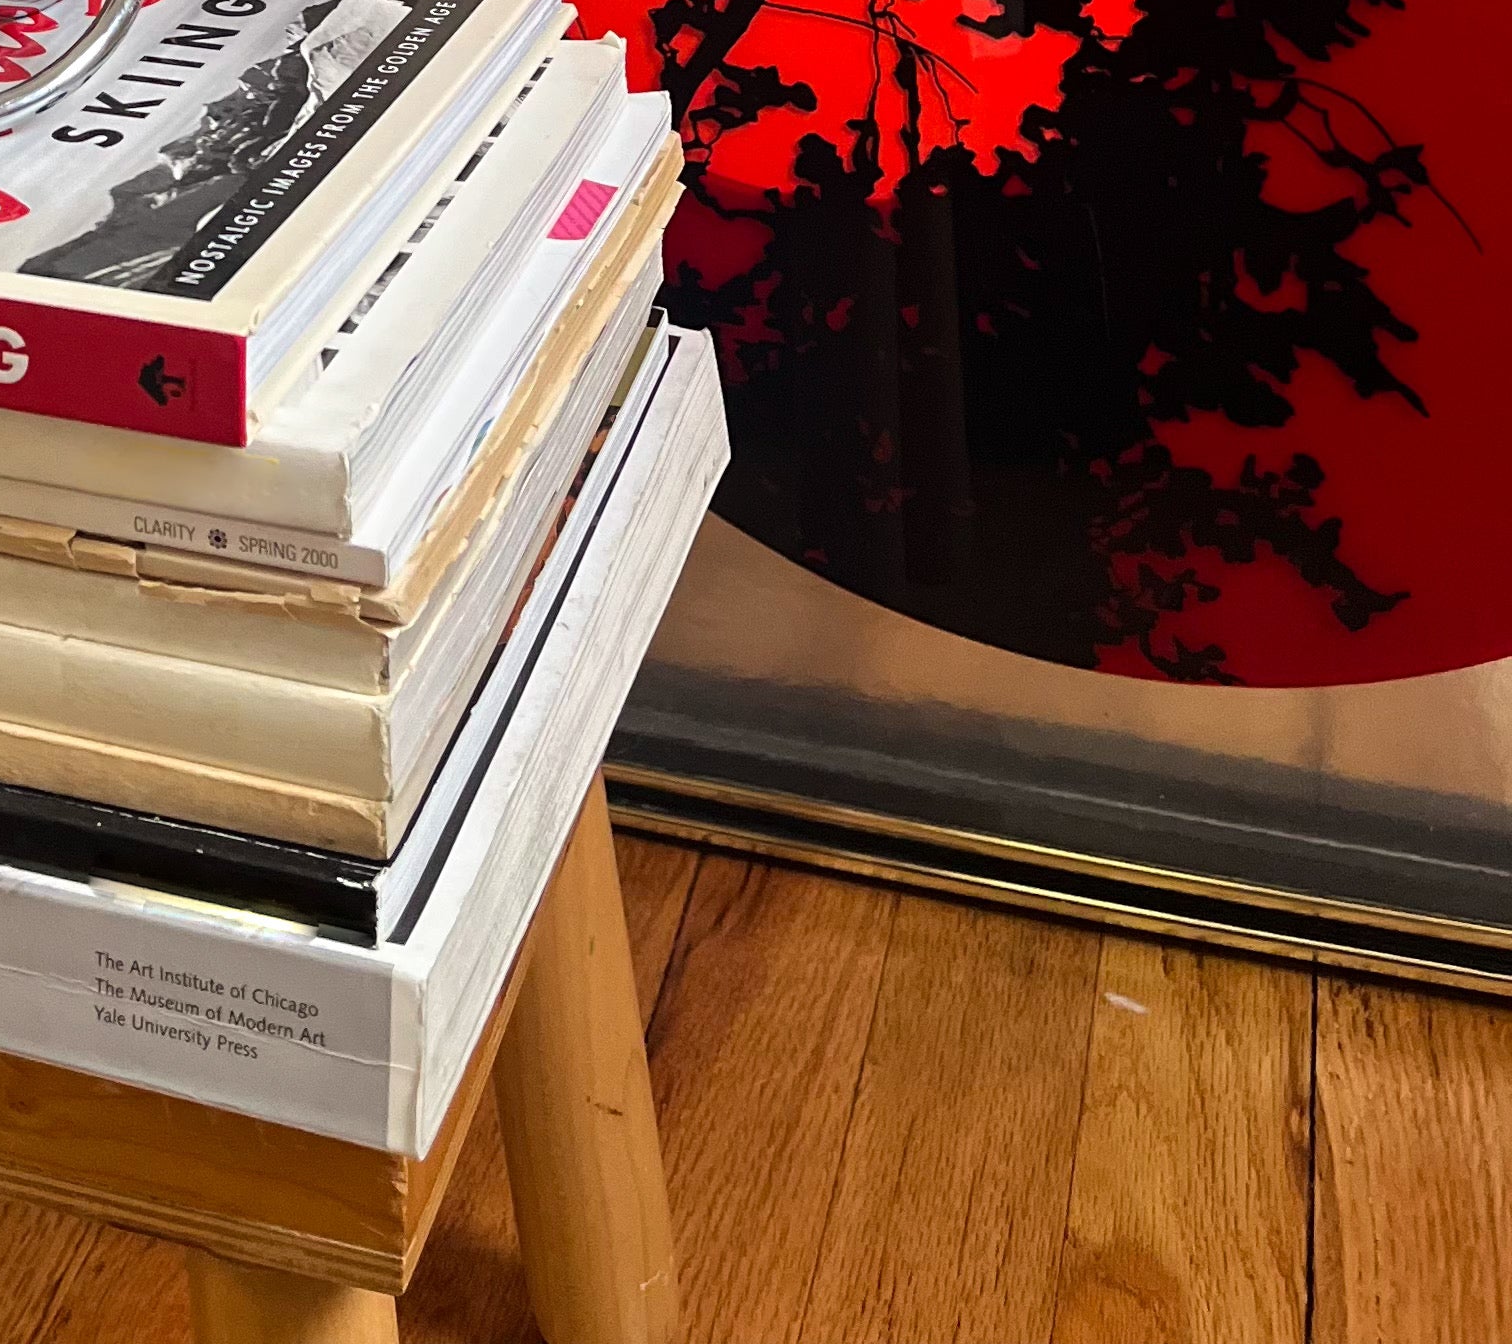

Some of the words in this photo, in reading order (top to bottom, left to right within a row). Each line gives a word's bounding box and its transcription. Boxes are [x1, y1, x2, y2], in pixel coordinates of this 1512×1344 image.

[175, 197, 275, 285] NOSTALGIC
[261, 142, 328, 196] IMAGES
[316, 102, 365, 140] FROM
[351, 71, 390, 101] THE
[376, 25, 434, 82] GOLDEN
[134, 515, 196, 542] CLARITY
[238, 535, 297, 563] SPRING
[300, 547, 339, 570] 2000
[95, 950, 124, 972] The
[129, 960, 154, 979] Art
[159, 965, 225, 996] Institute
[229, 983, 248, 1001] of
[252, 987, 319, 1020] Chicago
[95, 976, 124, 999] The
[129, 987, 200, 1017] Museum
[205, 1005, 224, 1022] of
[228, 1010, 294, 1039] Modern
[299, 1027, 327, 1048] Art
[94, 1004, 126, 1027] Yale
[131, 1013, 212, 1051] University
[216, 1033, 259, 1060] Press
